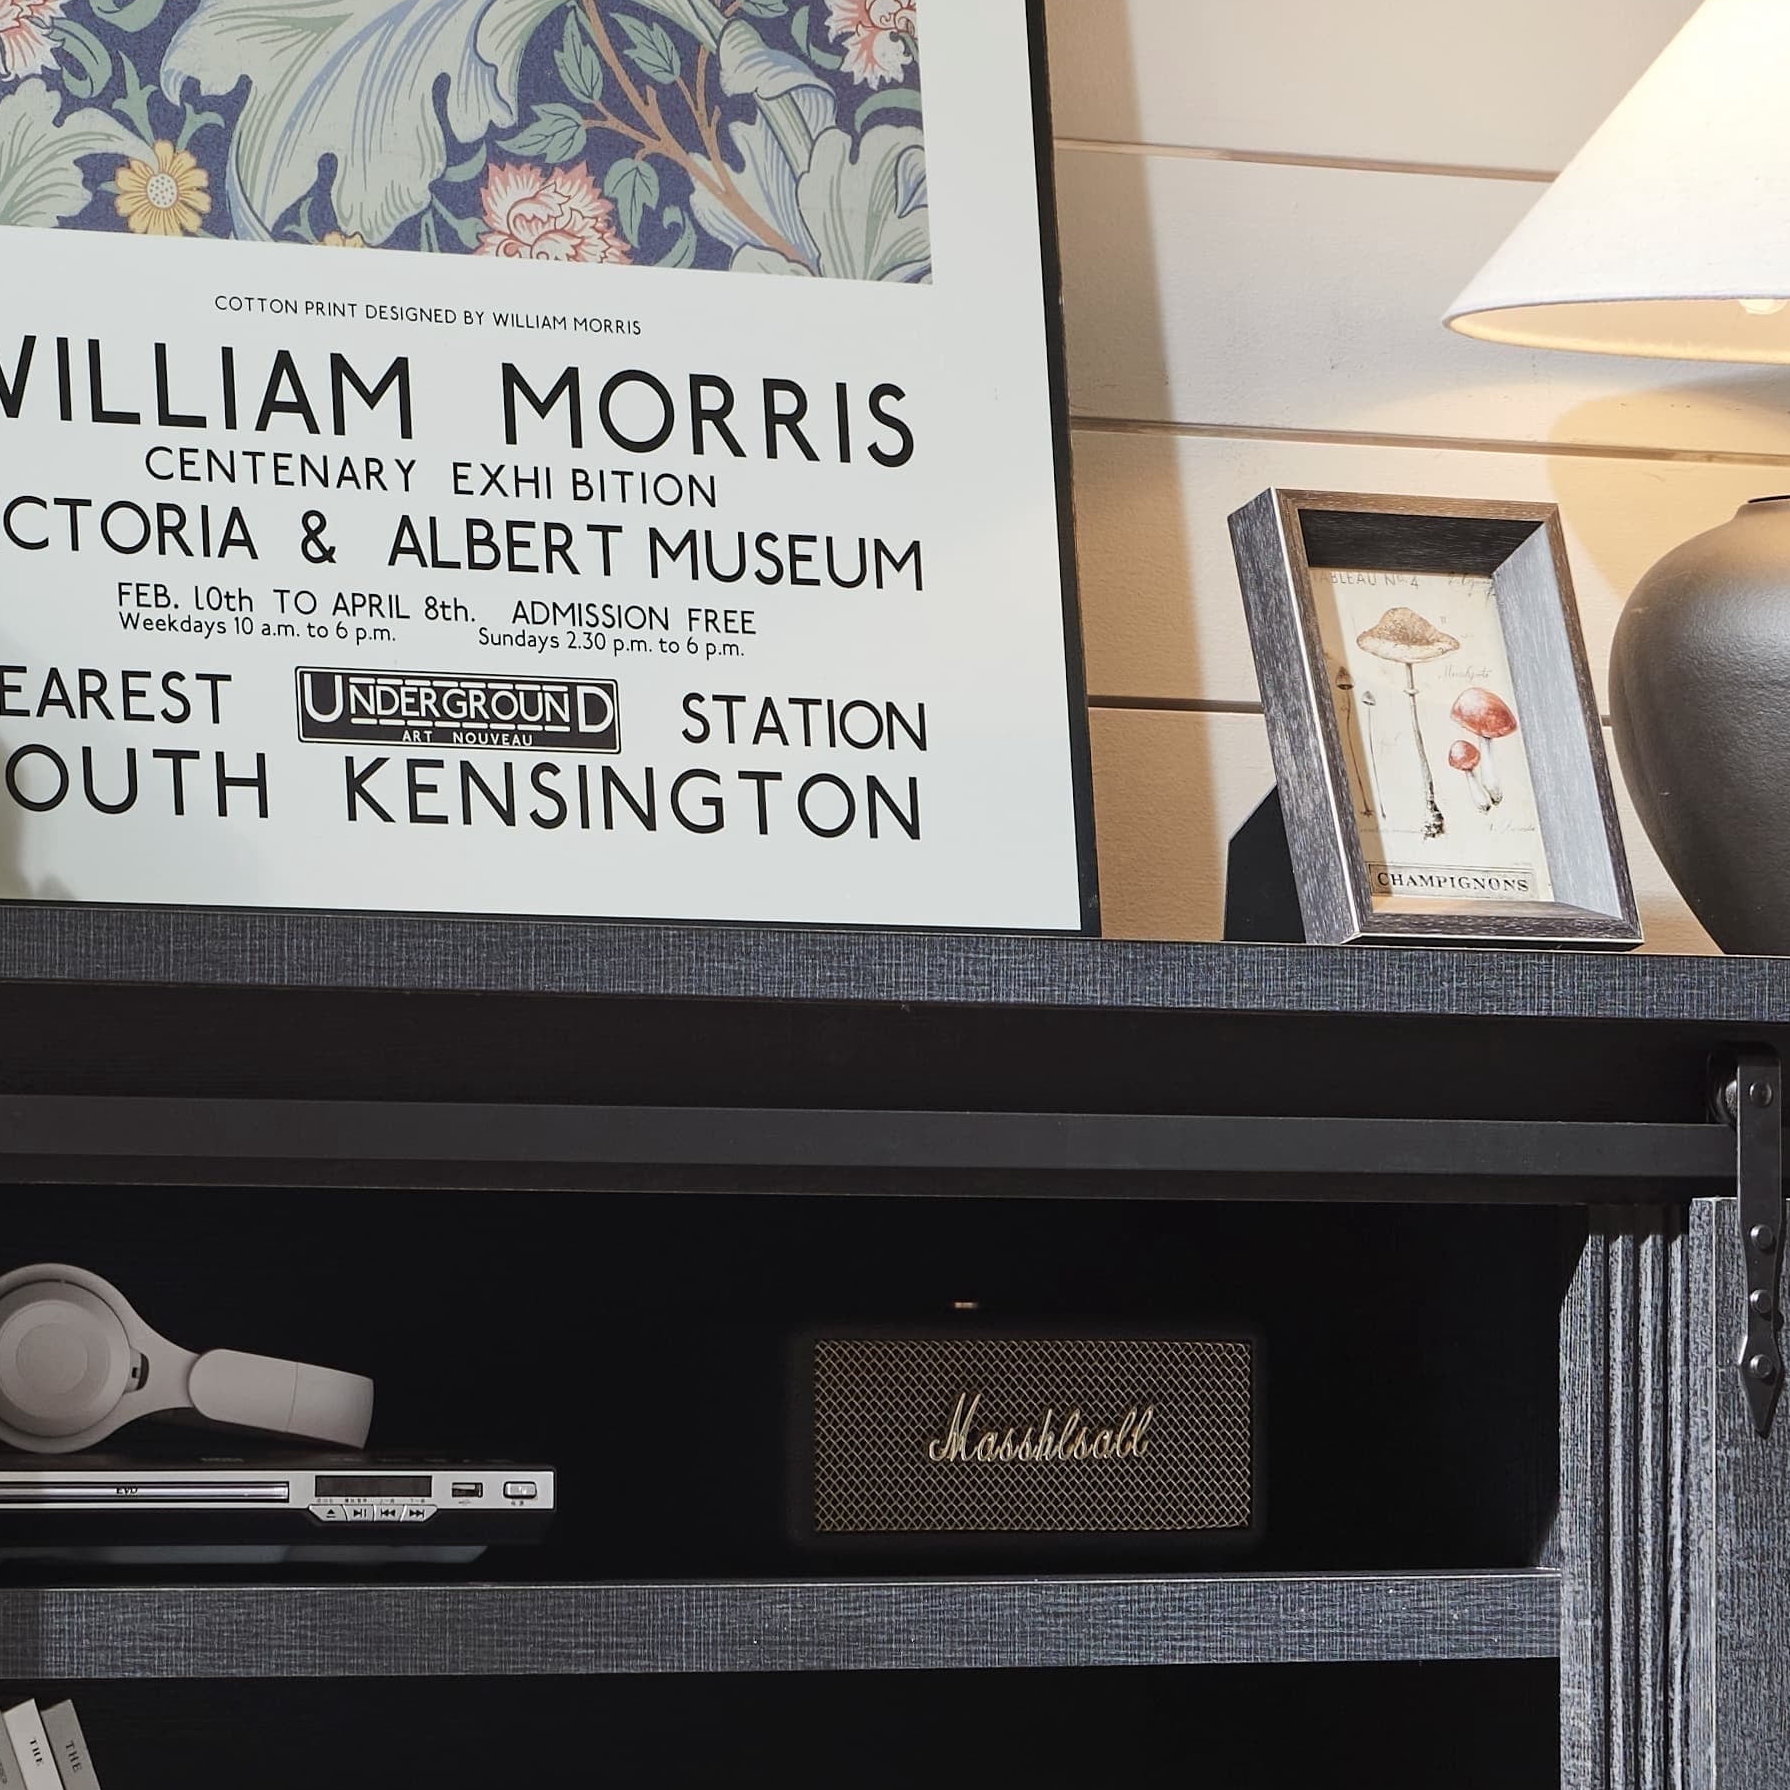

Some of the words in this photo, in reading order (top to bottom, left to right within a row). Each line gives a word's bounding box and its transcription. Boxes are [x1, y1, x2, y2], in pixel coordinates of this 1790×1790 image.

[215, 296, 297, 314] COTTON
[306, 301, 357, 317] PRINT
[366, 305, 456, 323] DESIGNED
[464, 311, 484, 325] BY
[493, 312, 566, 330] WILLIAM
[574, 317, 640, 335] MORRIS
[502, 363, 913, 467] MORRIS
[146, 446, 415, 492] CENTENARY
[453, 462, 715, 507] EXHIBITION
[301, 510, 336, 563] &
[388, 515, 622, 576] ALBERT
[649, 527, 922, 591] MUSEUM
[118, 582, 178, 609] FEB.
[273, 589, 316, 615] TO
[333, 592, 410, 619] APRIL
[425, 596, 475, 621] 8th.
[512, 601, 668, 630] ADMISSION
[688, 608, 756, 634] FREE
[119, 612, 226, 639] Weekdays
[235, 619, 253, 634] 10
[262, 624, 299, 636] a.m.
[307, 624, 328, 638] to
[336, 626, 348, 639] 6
[356, 628, 395, 645] p.m.
[479, 627, 559, 653] Sundays
[567, 631, 605, 650] 2.30
[614, 639, 652, 657] p.m.
[659, 638, 679, 653] to
[687, 638, 698, 654] 6
[706, 643, 744, 660] p.m.
[303, 673, 614, 733] UNDERGROUND
[682, 693, 927, 751] STATION
[402, 729, 433, 743] ART
[452, 731, 533, 746] NOUVEAU
[345, 756, 920, 840] KENSINGTON
[1377, 872, 1529, 892] CHAMPIGNONS
[66, 1740, 82, 1773] THE
